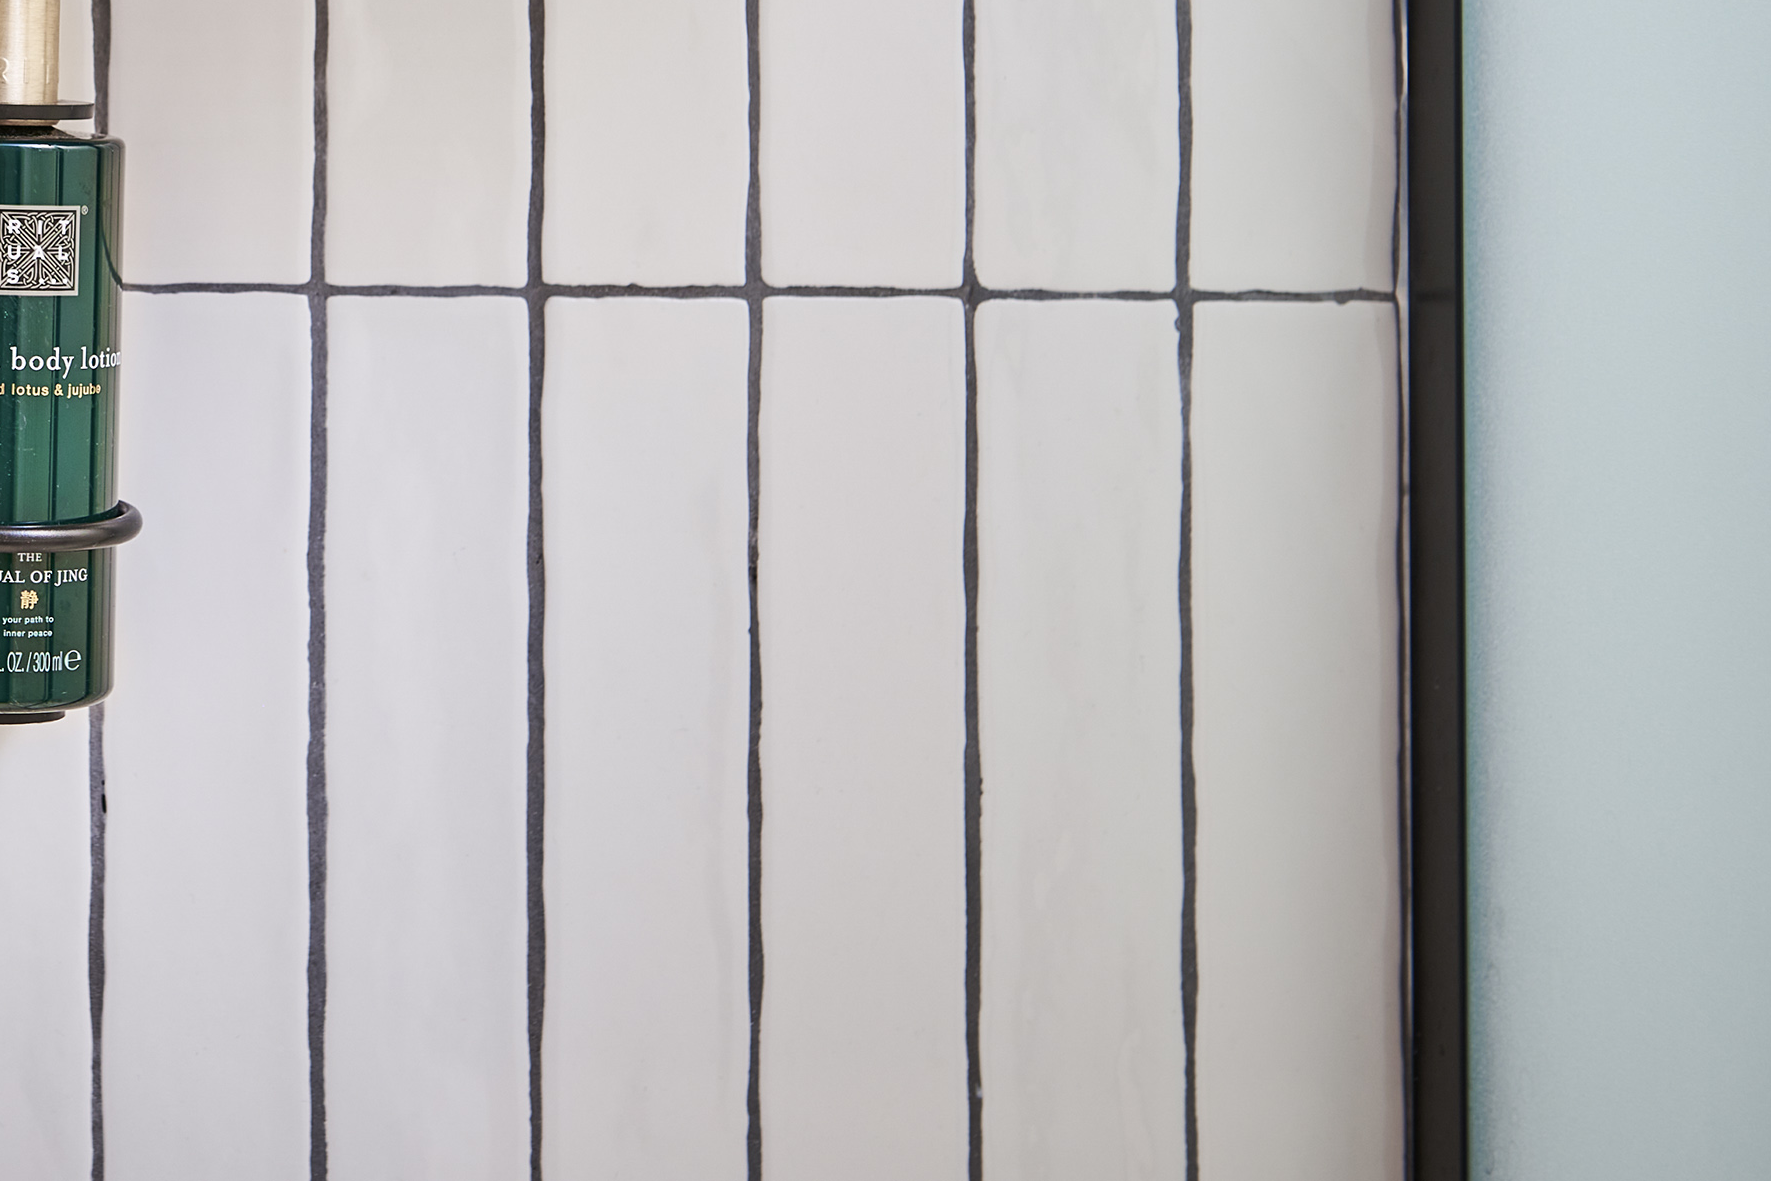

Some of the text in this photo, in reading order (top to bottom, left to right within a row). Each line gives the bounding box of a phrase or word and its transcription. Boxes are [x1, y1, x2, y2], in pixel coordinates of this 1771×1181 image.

[10, 346, 75, 379] body
[11, 383, 50, 397] lotus
[54, 384, 64, 397] &
[66, 383, 102, 399] jujube
[17, 552, 43, 562] THE
[30, 570, 53, 584] OF
[54, 568, 88, 587] JING
[2, 615, 55, 625] your path to
[3, 629, 53, 639] inner peace
[6, 651, 25, 673] OZ.
